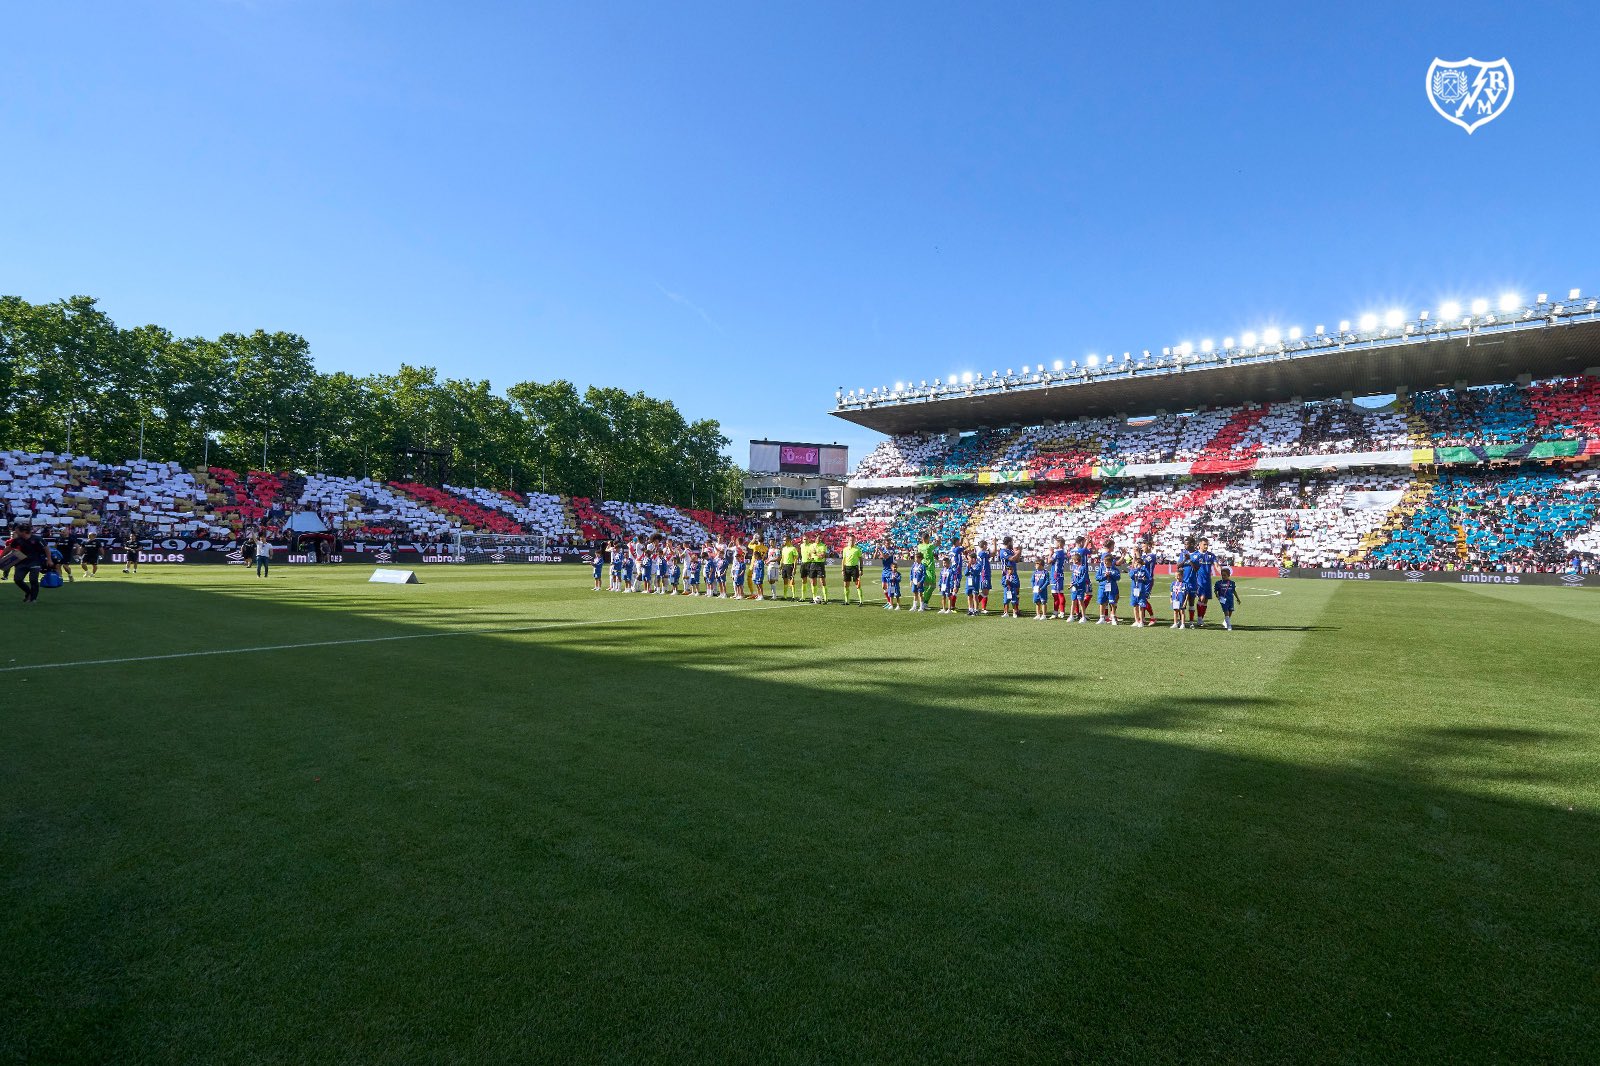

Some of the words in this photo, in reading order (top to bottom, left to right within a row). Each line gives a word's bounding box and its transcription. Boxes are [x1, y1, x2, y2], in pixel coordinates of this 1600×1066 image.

[422, 554, 466, 563] umbro.es
[528, 554, 562, 562] umbro.es
[1321, 570, 1370, 580] umbro.es
[1461, 573, 1520, 584] umbro.es
